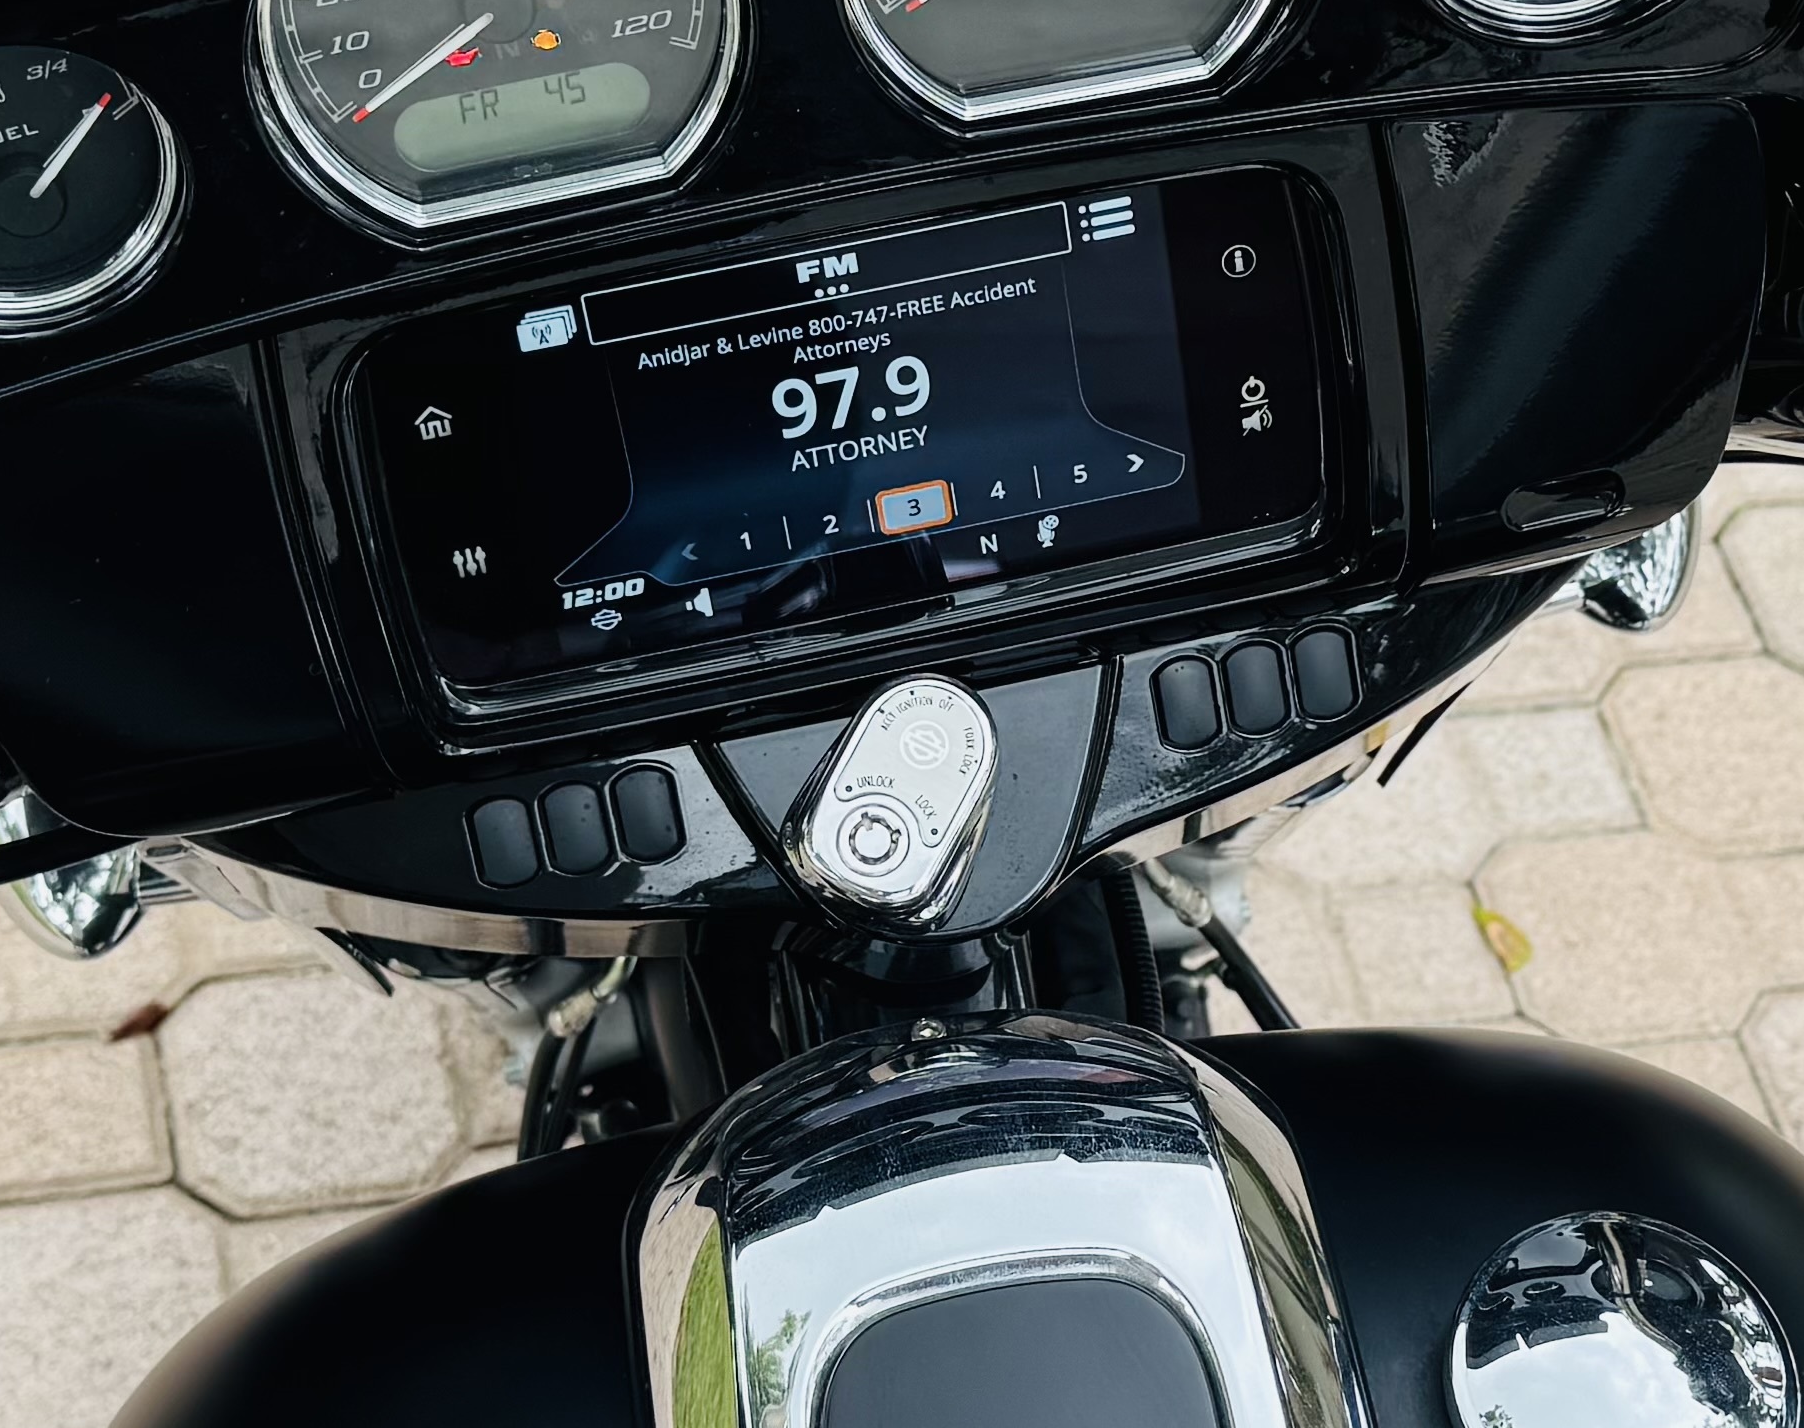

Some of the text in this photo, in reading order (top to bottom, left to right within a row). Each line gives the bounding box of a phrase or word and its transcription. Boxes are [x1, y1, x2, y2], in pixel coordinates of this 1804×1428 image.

[610, 9, 673, 39] 120
[330, 31, 370, 56] 10
[26, 57, 69, 82] 3/4
[358, 69, 383, 90] 0
[544, 72, 586, 106] 45
[796, 252, 859, 284] FM
[637, 276, 1037, 369] Anidjar & Levine 800-747-FREE Accident
[793, 331, 891, 364] Attorneys
[771, 355, 931, 439] 97.9
[791, 425, 928, 472] ATTORNEY
[739, 464, 1088, 551] 1 2 3 4 5
[980, 535, 999, 555] N
[561, 578, 645, 610] 12:00
[857, 776, 896, 790] UNLOCK
[915, 795, 938, 820] LOCK
